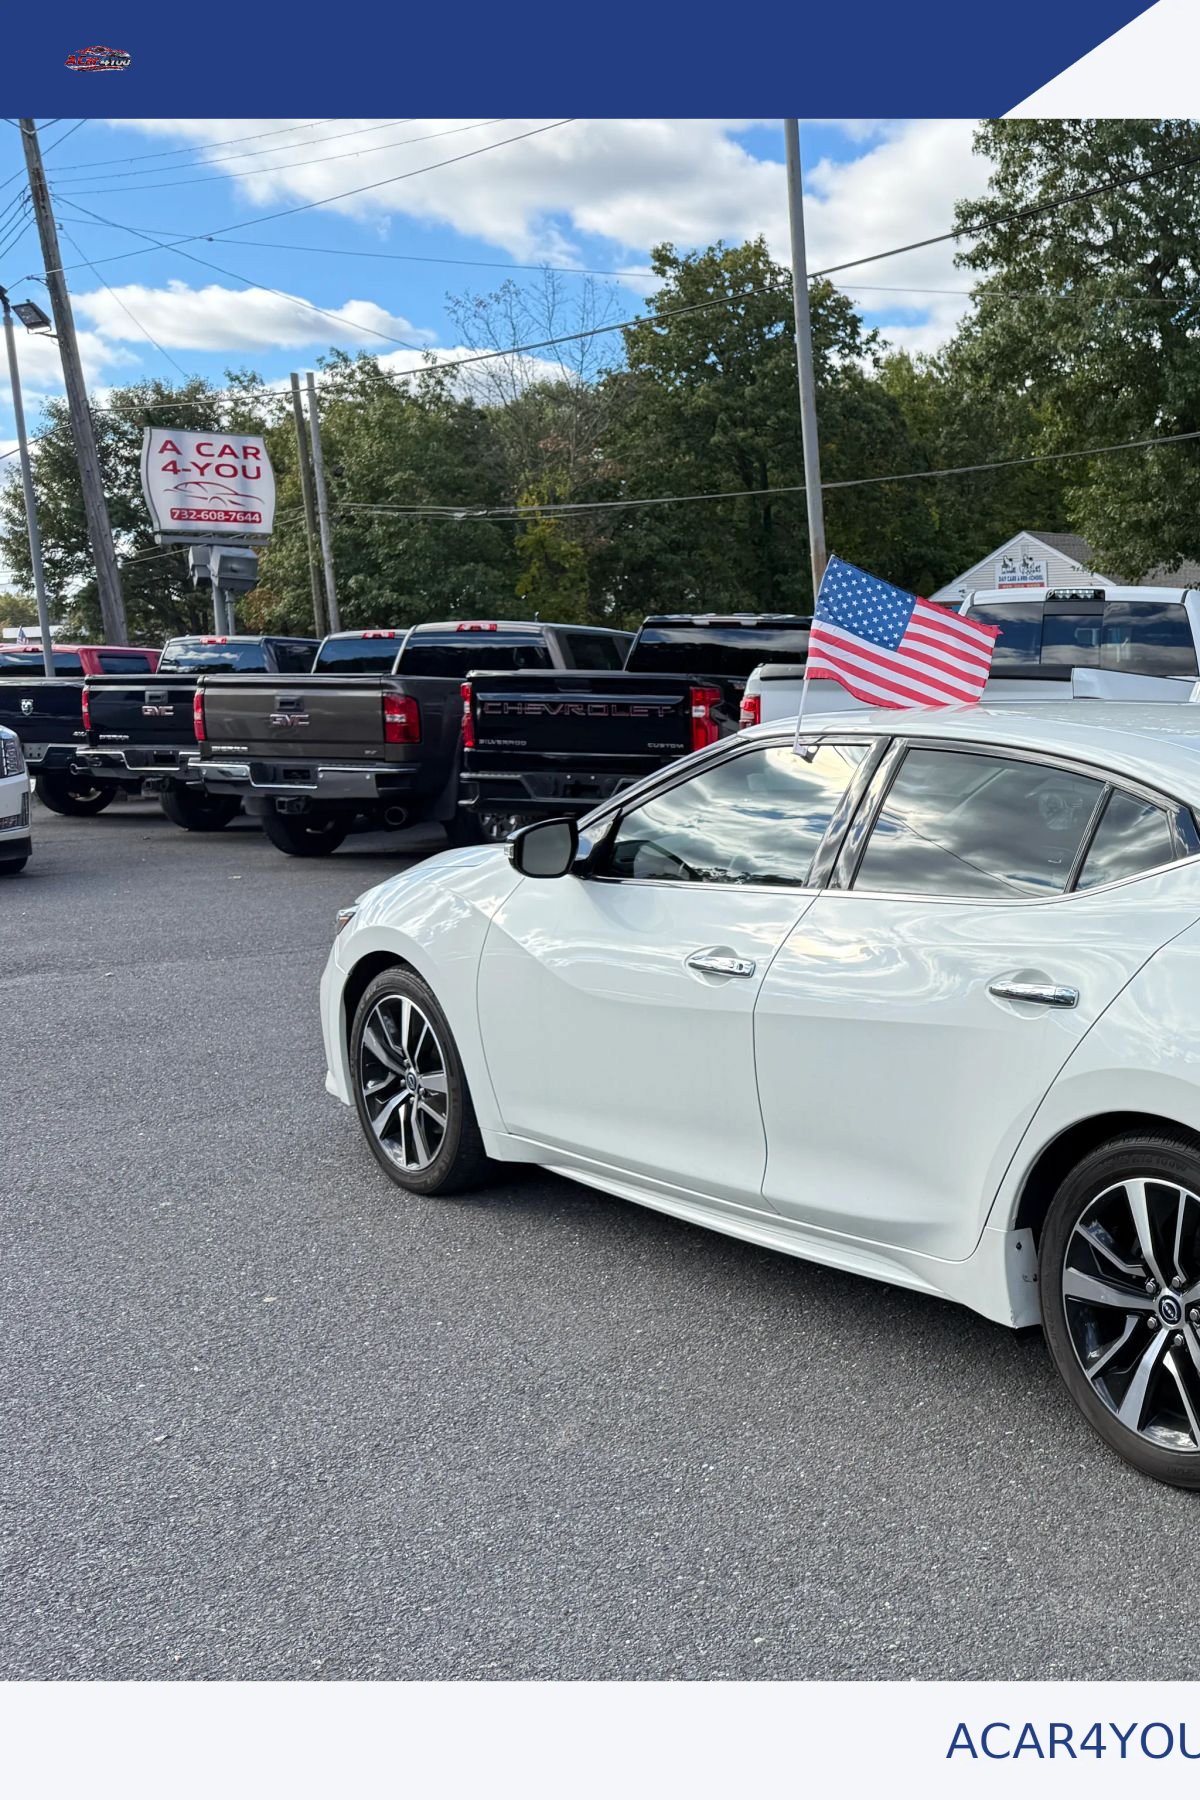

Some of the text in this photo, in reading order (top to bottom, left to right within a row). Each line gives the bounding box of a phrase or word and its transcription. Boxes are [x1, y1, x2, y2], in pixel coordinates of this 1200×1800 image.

[159, 439, 262, 460] A CAR
[161, 460, 262, 480] 4-YOU
[171, 508, 261, 523] 732-608-7644
[142, 705, 174, 716] GMC
[483, 701, 672, 719] CHEVROLET
[270, 713, 310, 727] GMC
